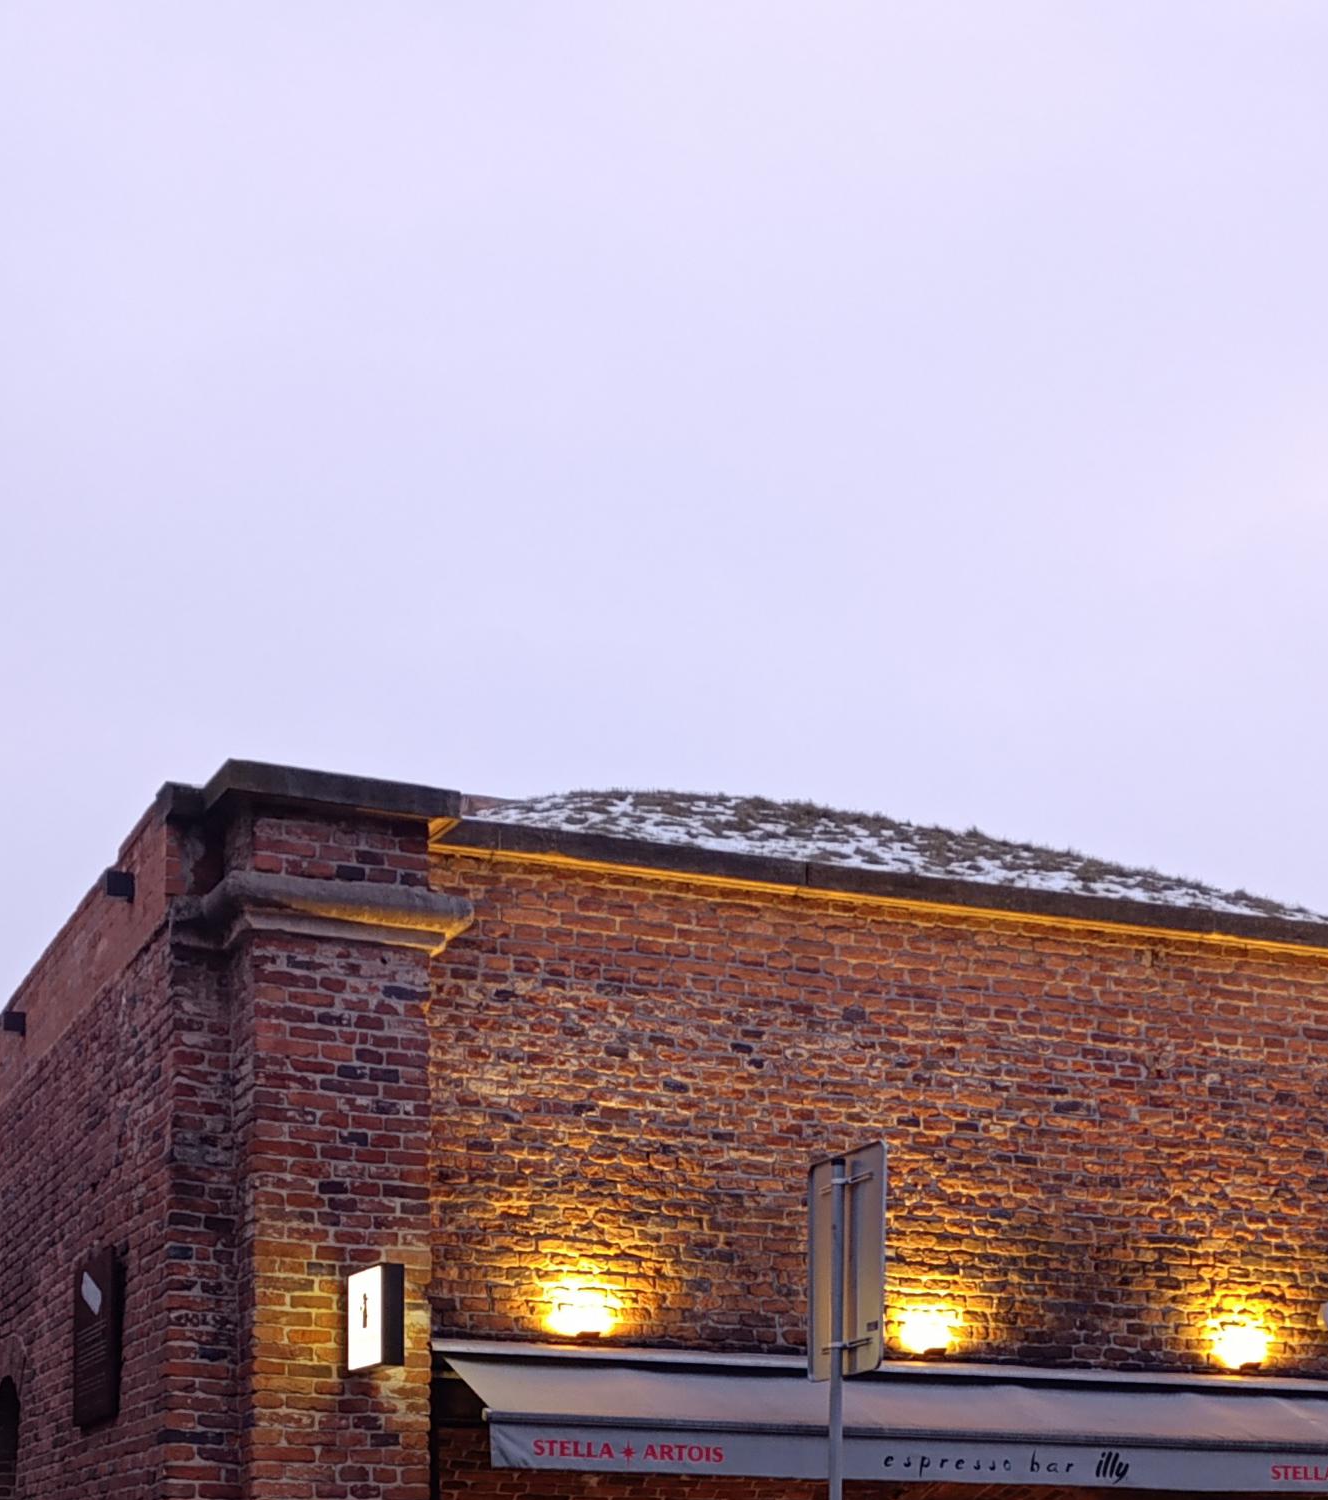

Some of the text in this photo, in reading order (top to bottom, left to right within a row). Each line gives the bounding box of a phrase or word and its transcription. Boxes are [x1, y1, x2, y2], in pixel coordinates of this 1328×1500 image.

[533, 1439, 725, 1463] STELLA ARTOIS
[884, 1450, 1130, 1484] espresso bar illy
